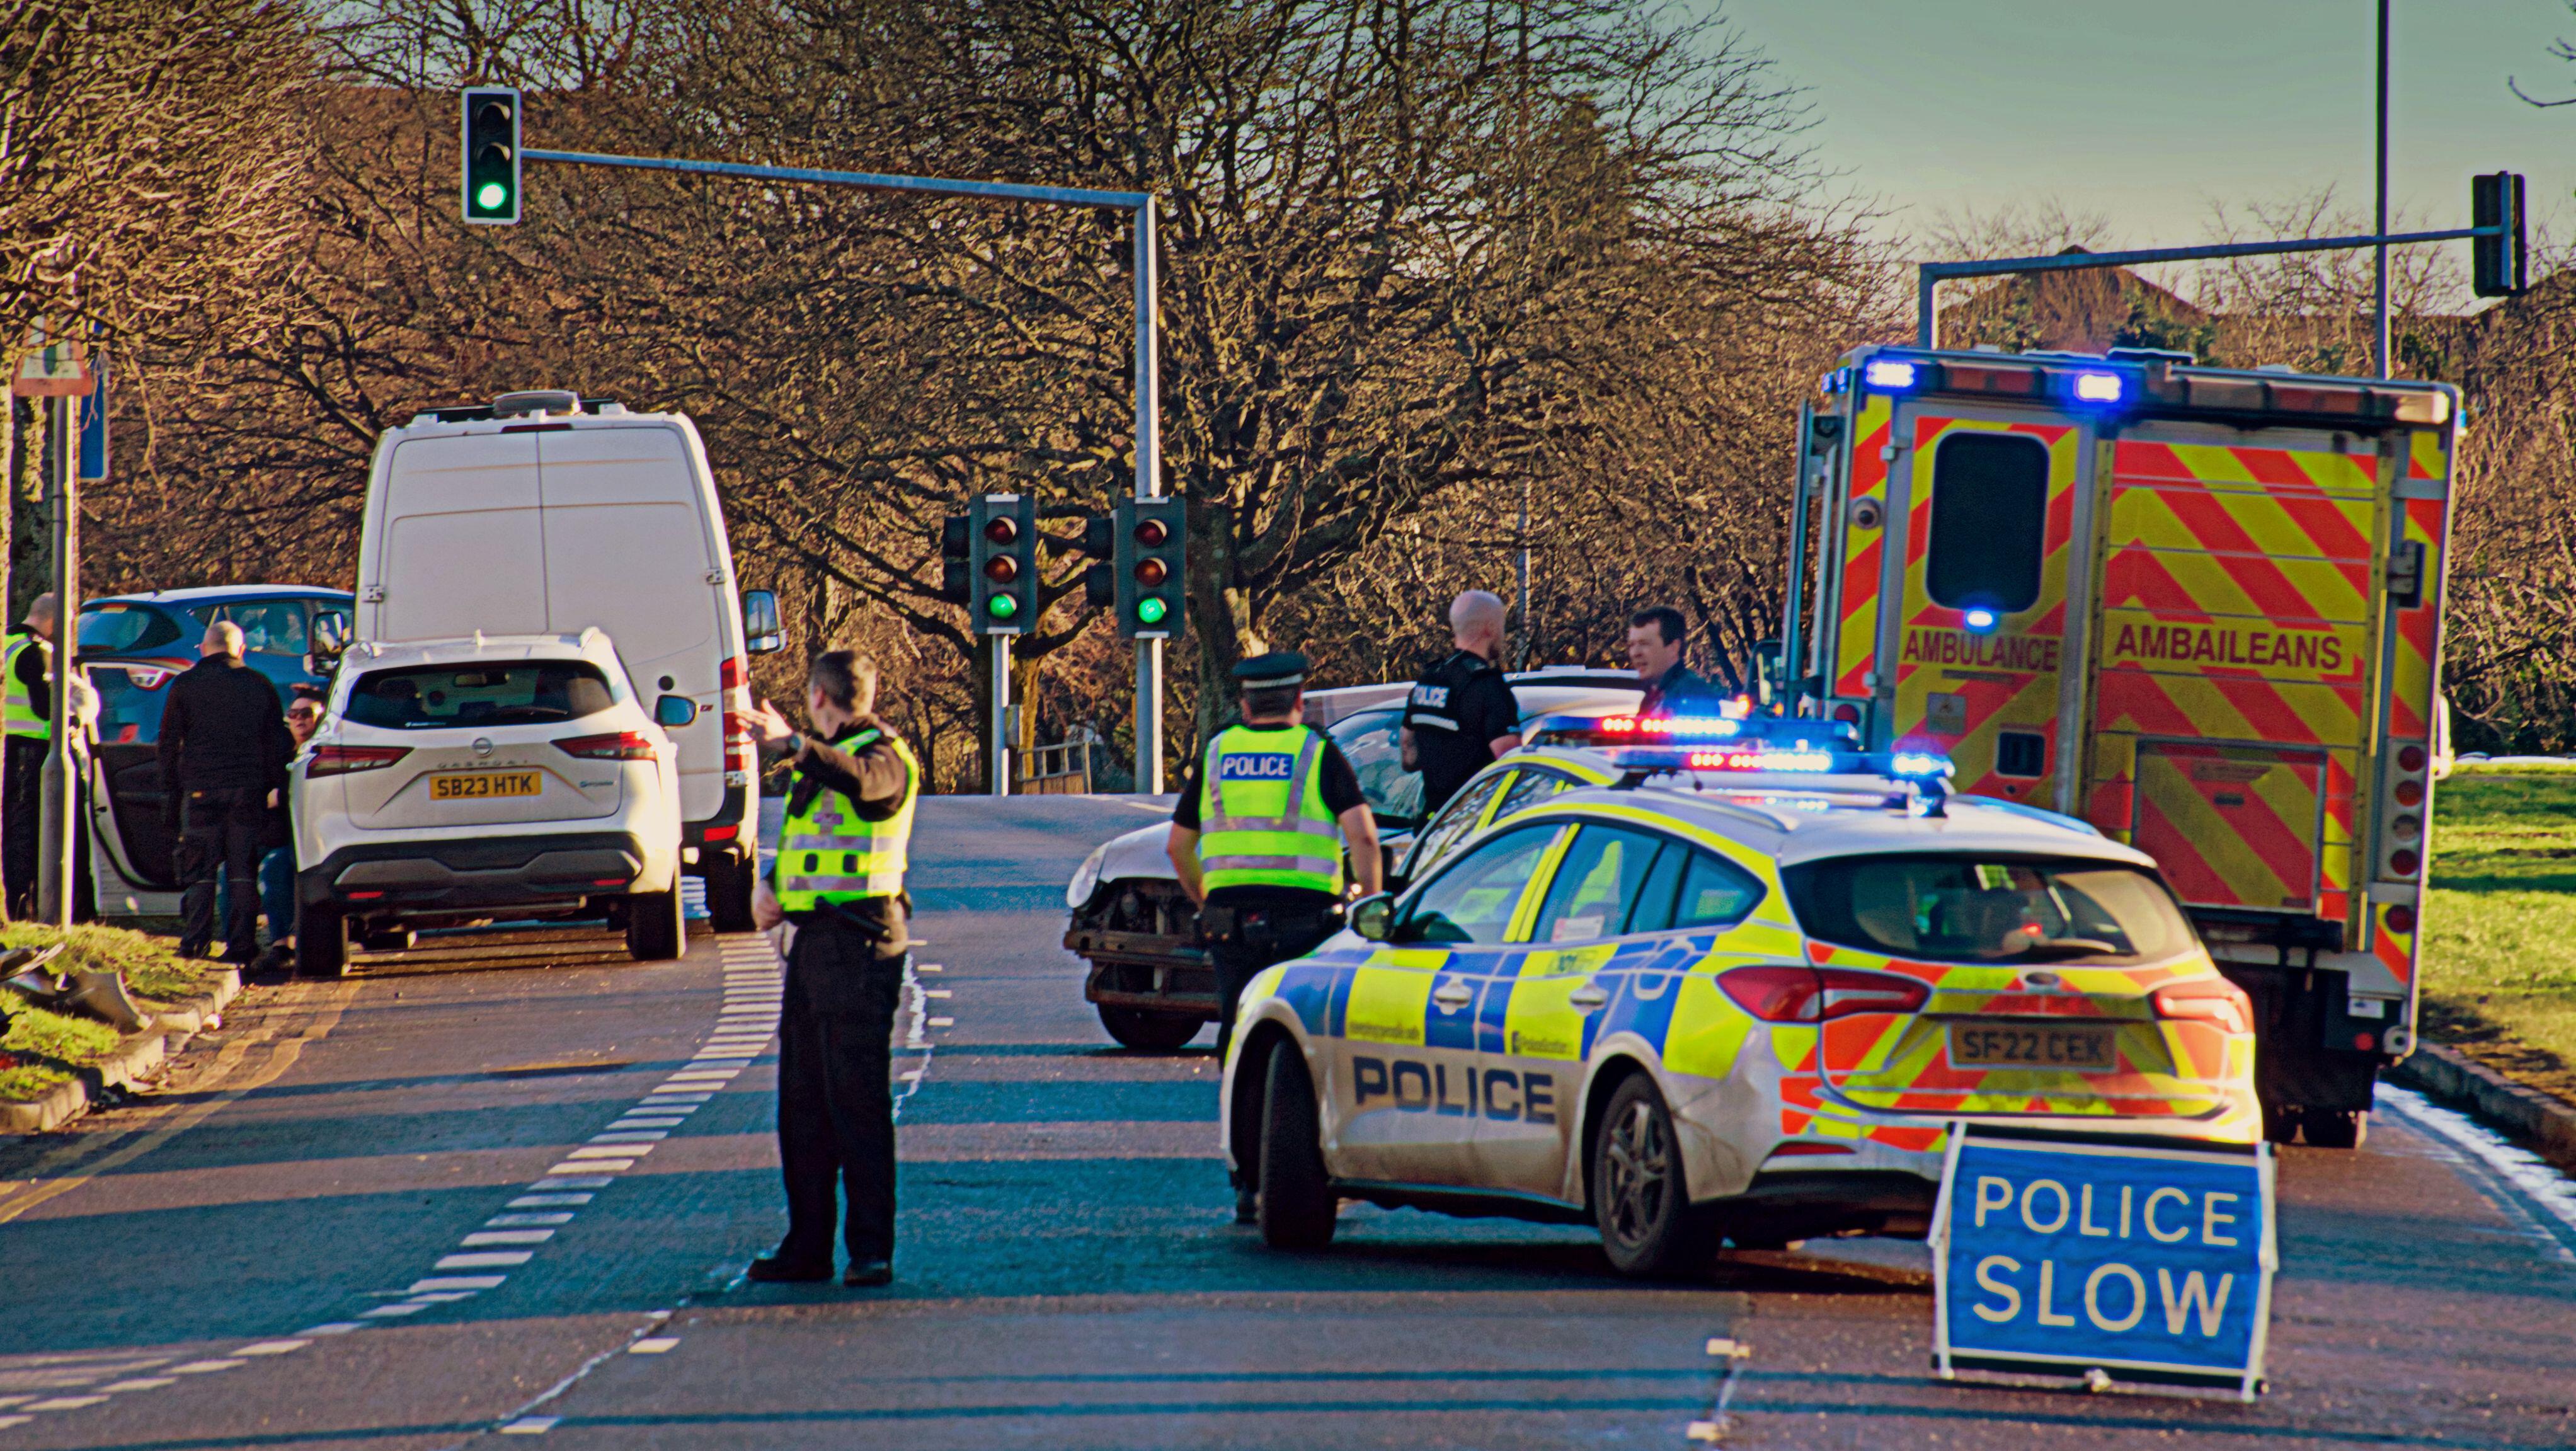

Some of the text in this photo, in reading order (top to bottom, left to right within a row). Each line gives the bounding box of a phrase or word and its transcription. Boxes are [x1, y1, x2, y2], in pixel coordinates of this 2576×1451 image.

[1903, 629, 2059, 672] AMBULANCE
[2114, 624, 2342, 670] AMBAILEANS
[438, 775, 532, 796] SB23 HTK
[1223, 756, 1289, 776] POLICE
[1964, 1031, 2039, 1060] SF22
[1353, 1055, 1555, 1125] POLICE
[1975, 1176, 2238, 1247] POLICE
[1972, 1255, 2234, 1338] SLOW
